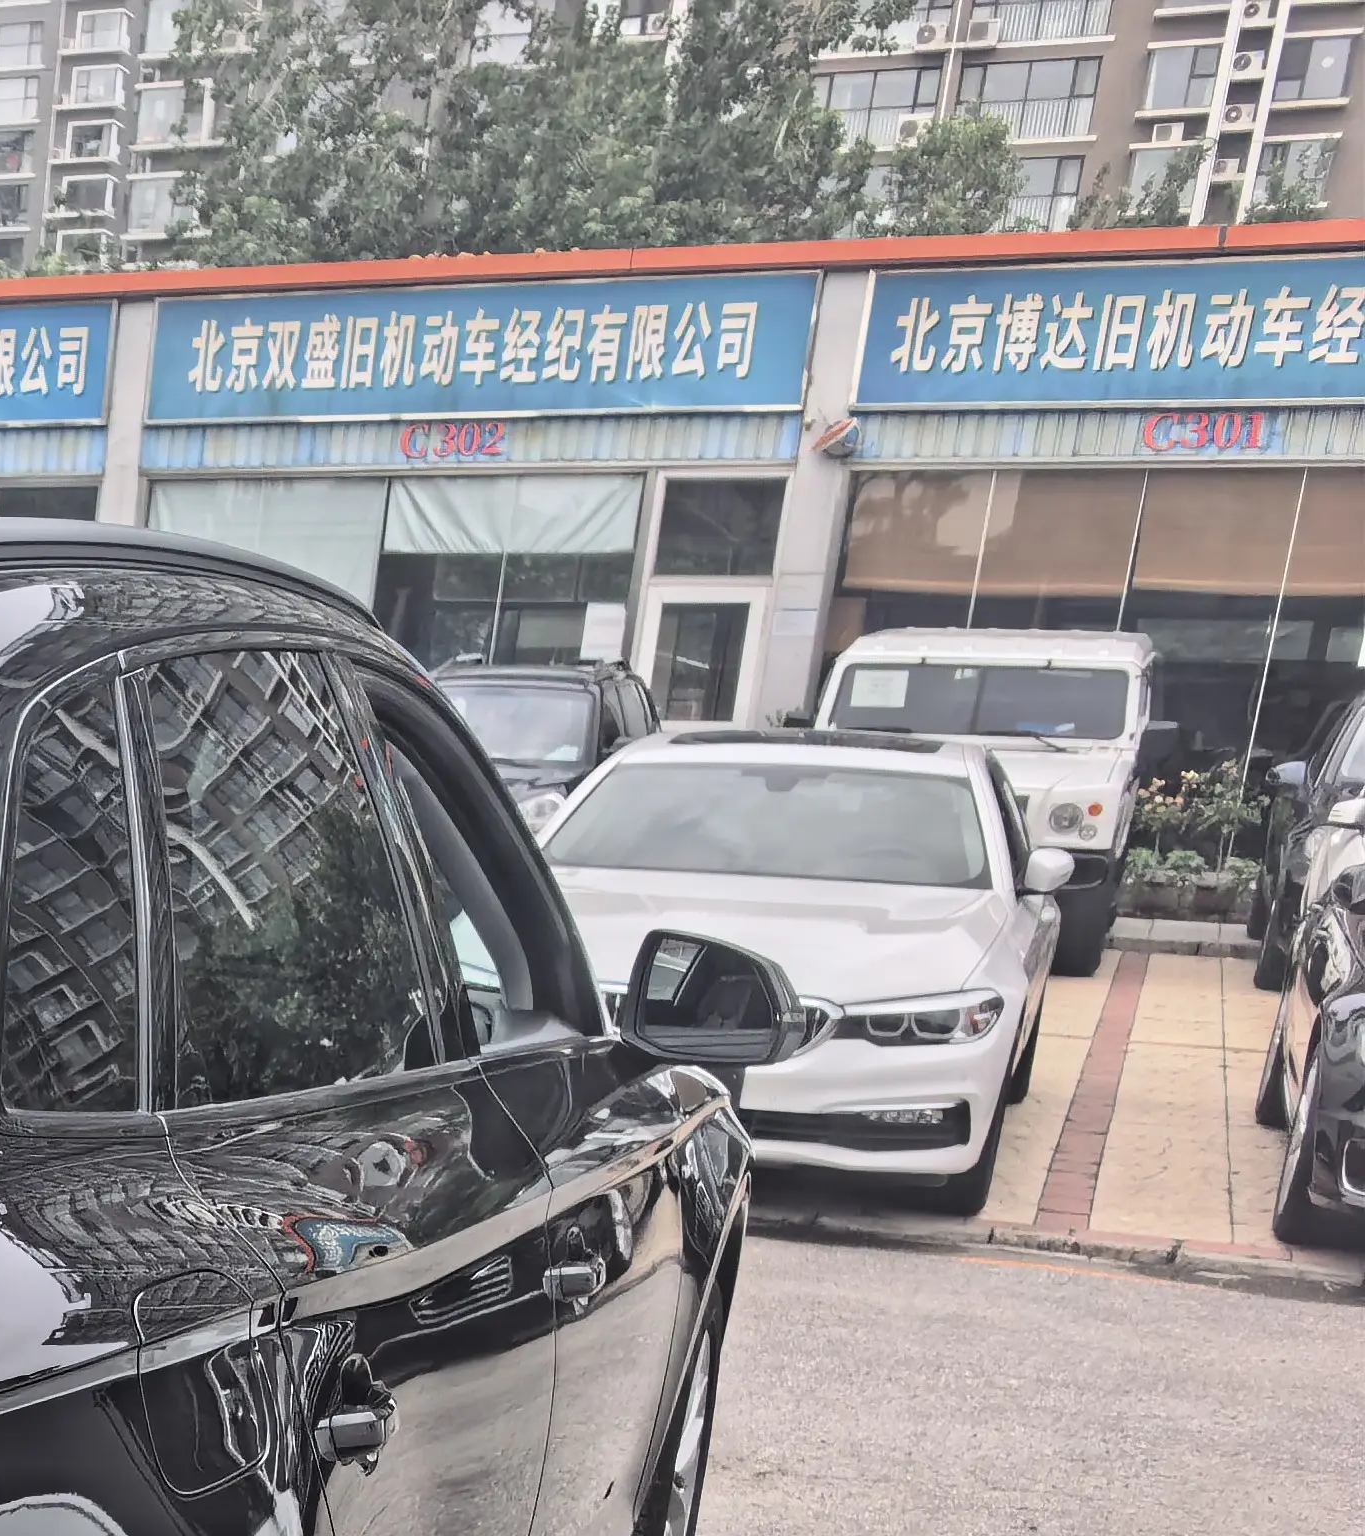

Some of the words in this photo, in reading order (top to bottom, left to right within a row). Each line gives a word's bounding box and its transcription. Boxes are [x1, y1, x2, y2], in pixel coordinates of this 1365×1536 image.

[187, 301, 759, 393] 北京双盛旧机动车经纪有限公司
[890, 283, 1365, 374] 北京博达旧机动车经
[399, 421, 506, 461] C302
[1143, 412, 1268, 452] C301
